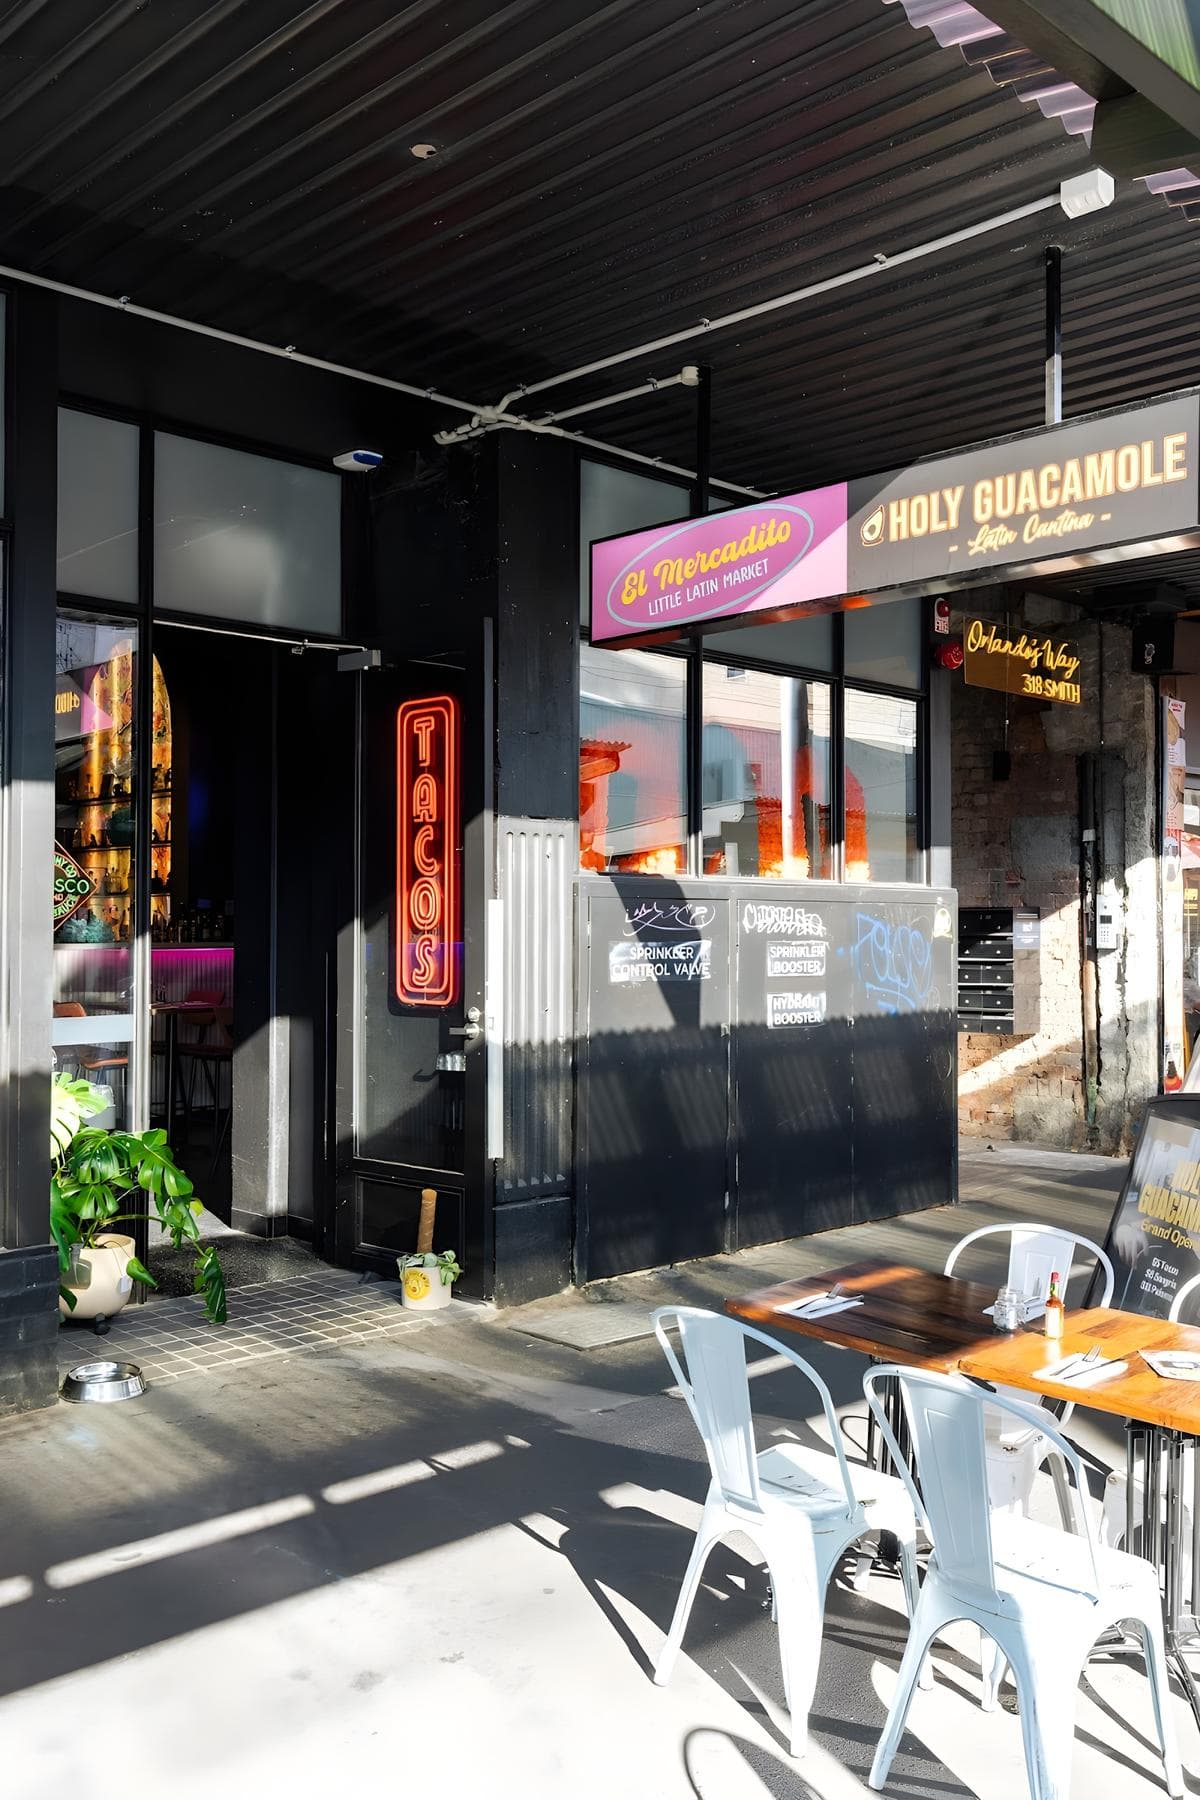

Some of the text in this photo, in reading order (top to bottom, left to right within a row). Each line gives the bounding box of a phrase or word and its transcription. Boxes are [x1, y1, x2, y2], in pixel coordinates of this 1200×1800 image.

[889, 432, 1188, 542] HOLY GUACAMOLE
[967, 509, 1094, 556] Latin Cantina
[621, 518, 793, 606] El Mercadito
[648, 558, 769, 616] LITTLE LATIN MARKET
[967, 620, 1080, 679] Orlando's Way
[1022, 674, 1081, 704] 318 SMITH
[410, 716, 441, 986] TACOS
[630, 947, 694, 960] SPRINKLER
[770, 946, 825, 958] SPRINKLER
[773, 961, 821, 973] BOOSTER
[611, 962, 711, 976] CONTROL VALVE
[774, 1011, 821, 1025] BOOSTER
[1141, 1218, 1172, 1240] Grand
